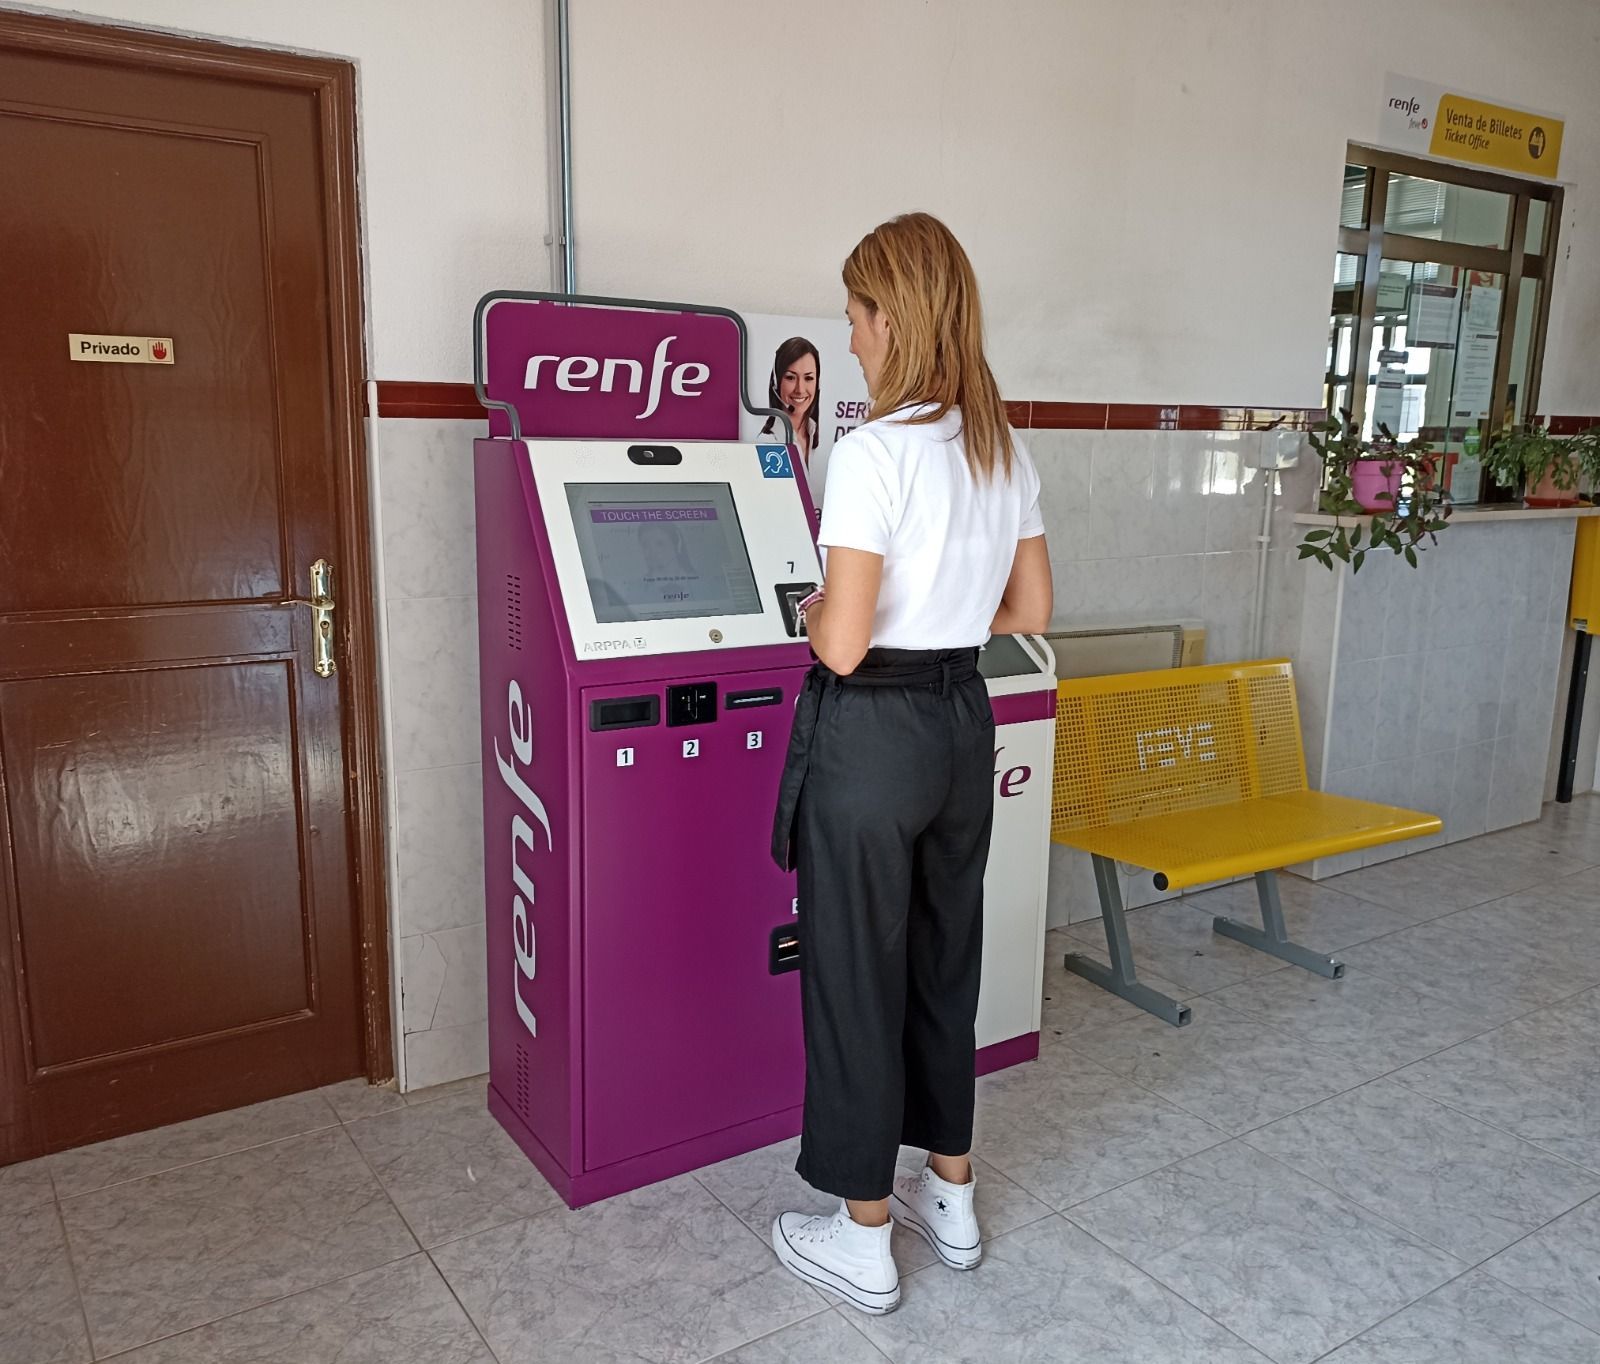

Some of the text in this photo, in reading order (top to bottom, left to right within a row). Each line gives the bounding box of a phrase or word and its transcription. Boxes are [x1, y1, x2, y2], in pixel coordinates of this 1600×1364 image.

[1388, 96, 1420, 117] renfe
[1446, 108, 1523, 141] Venta de Billetes
[1444, 128, 1490, 150] Ticket Office
[80, 341, 141, 356] Privado
[523, 335, 710, 420] renfe
[601, 509, 708, 521] TOUCH THE SCREEN
[786, 561, 795, 574] 7
[749, 733, 759, 747] 3
[620, 749, 629, 764] 1
[686, 742, 696, 756] 2
[494, 679, 552, 1038] renfe
